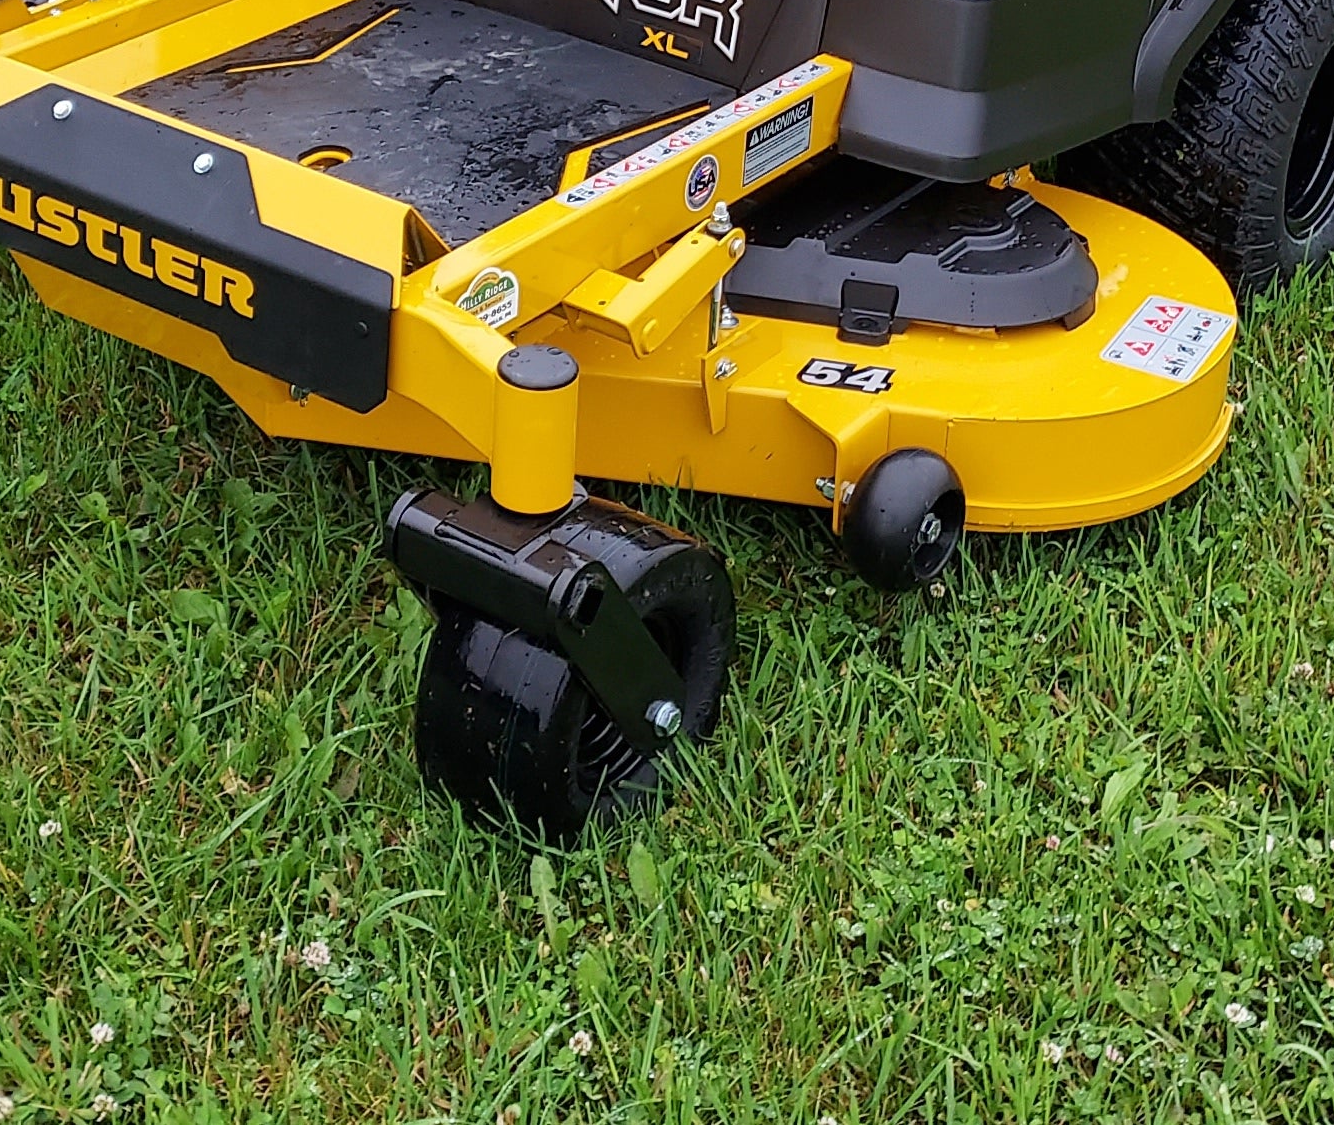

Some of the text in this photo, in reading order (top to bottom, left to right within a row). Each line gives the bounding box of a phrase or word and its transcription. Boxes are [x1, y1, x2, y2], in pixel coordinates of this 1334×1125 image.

[640, 26, 689, 59] XL
[760, 101, 810, 141] WARNING!
[688, 169, 716, 197] USA
[484, 279, 508, 299] RIDGE
[800, 359, 891, 393] 54
